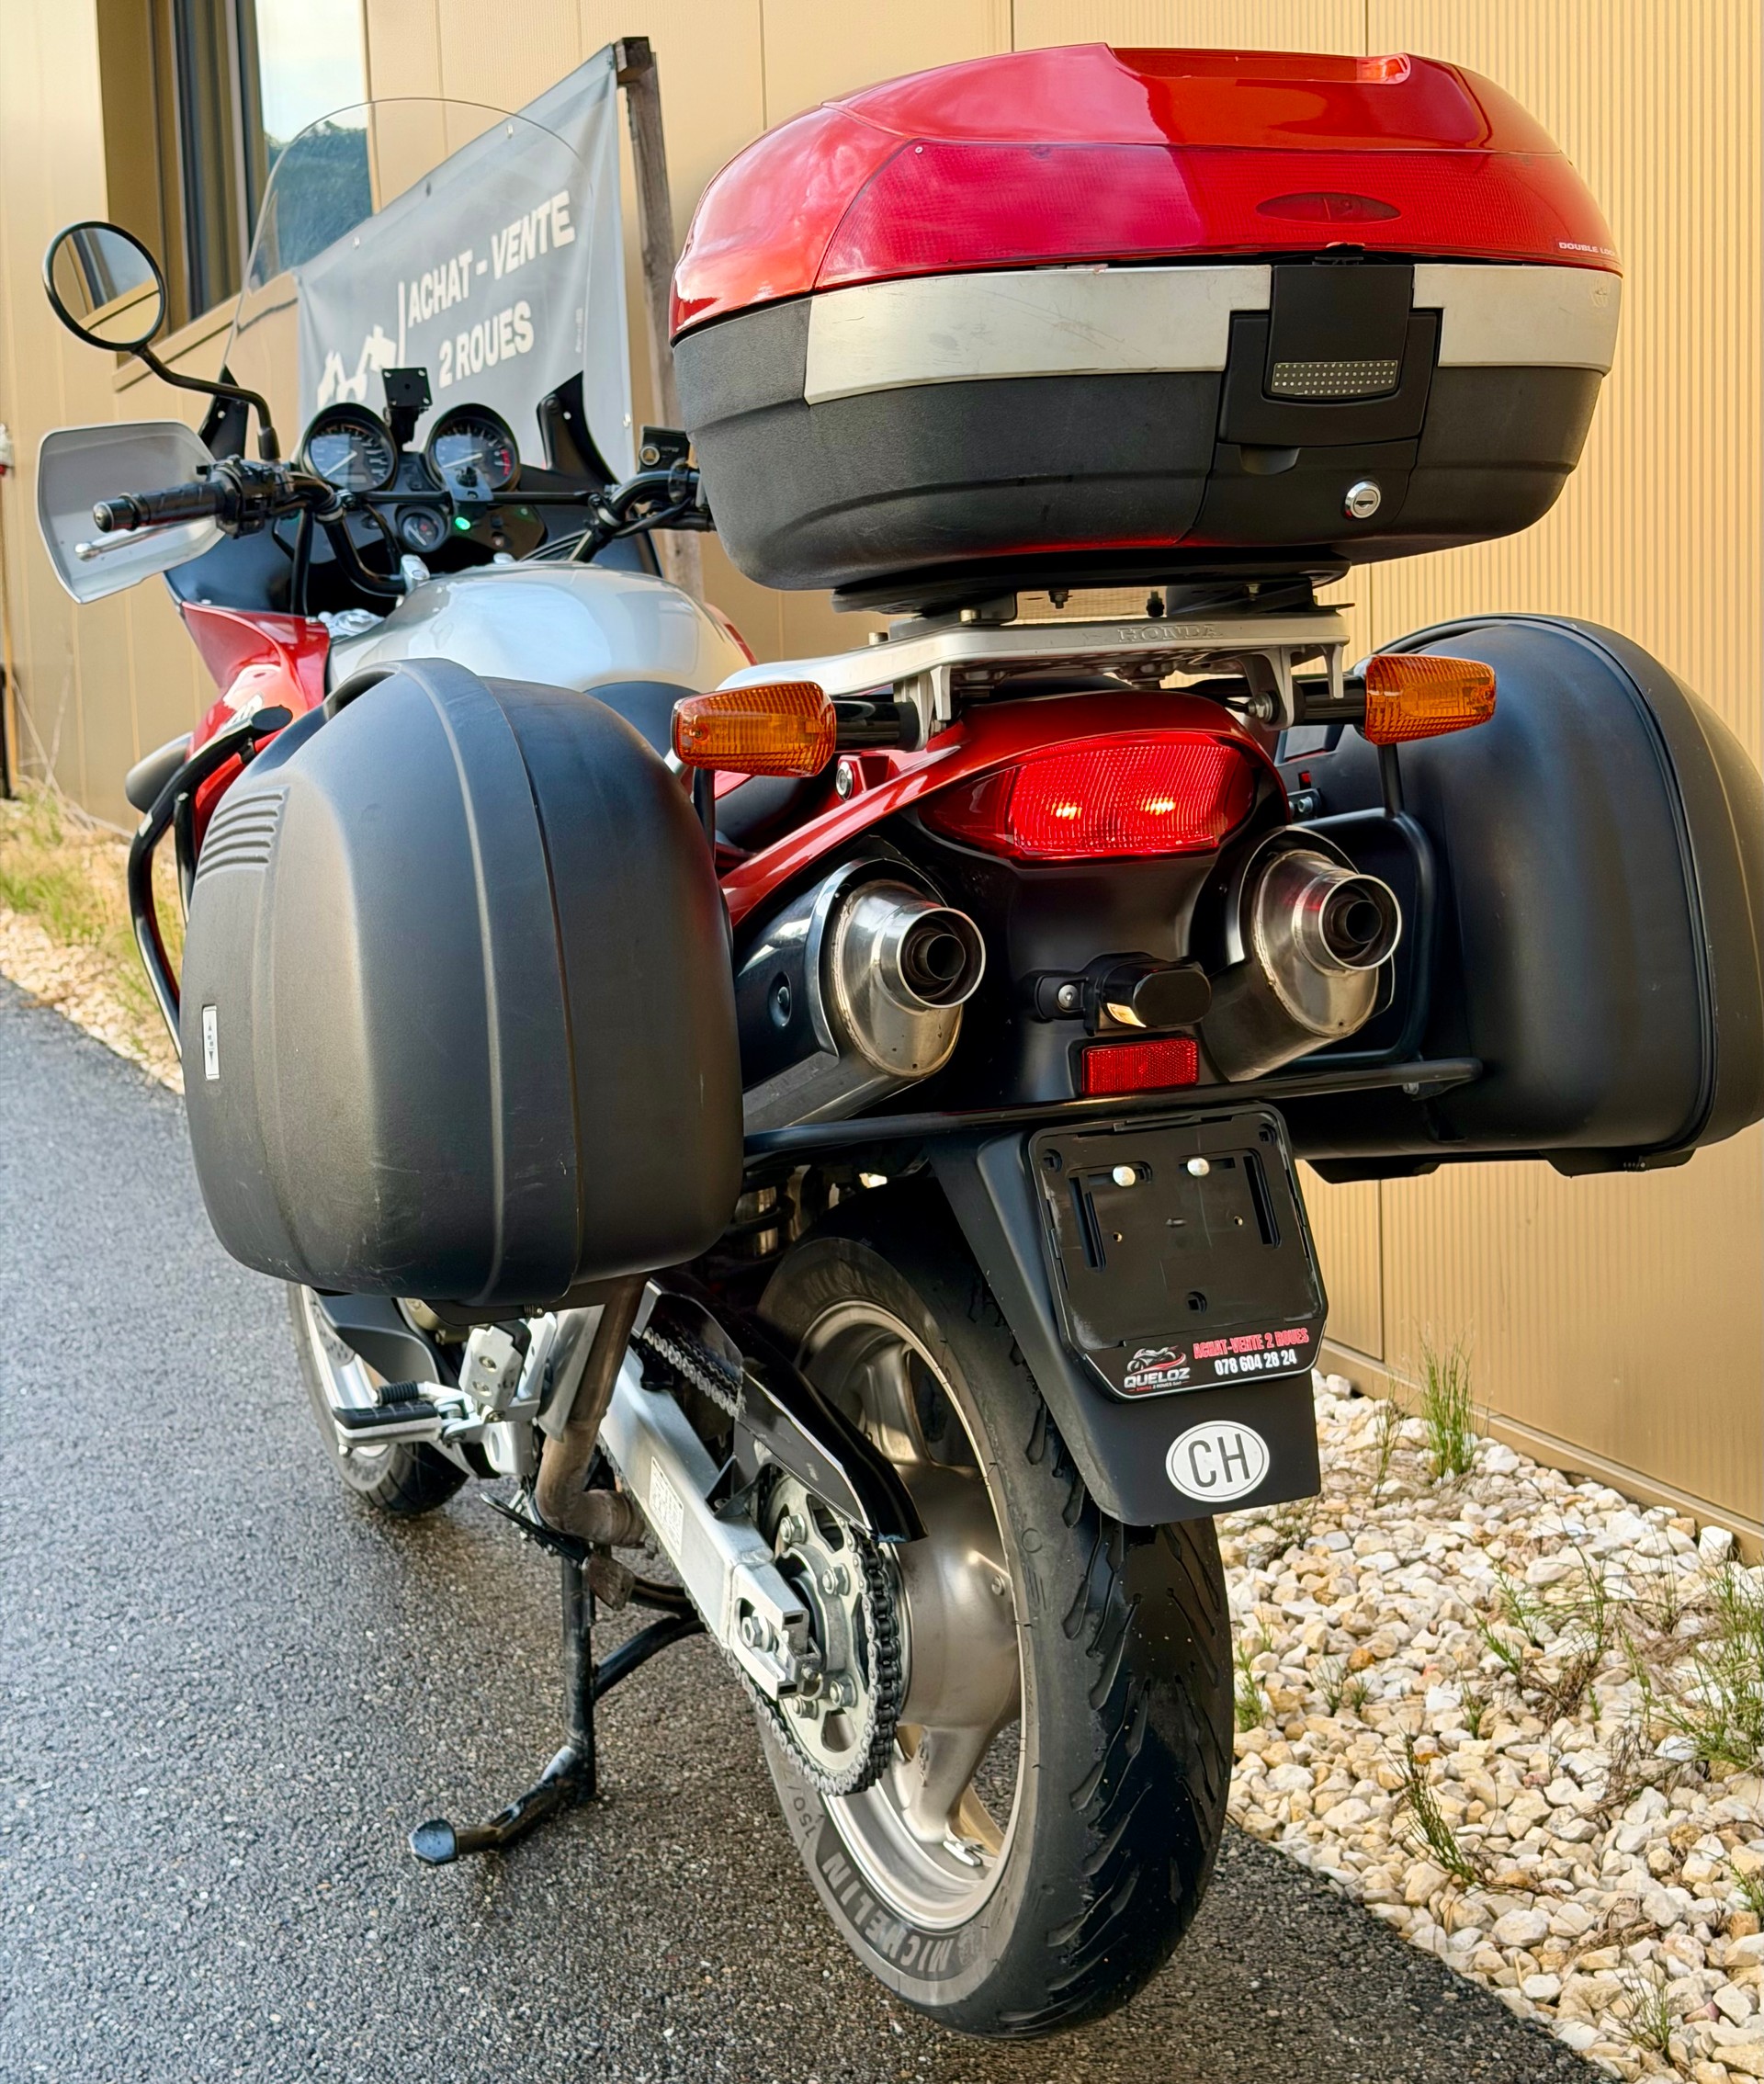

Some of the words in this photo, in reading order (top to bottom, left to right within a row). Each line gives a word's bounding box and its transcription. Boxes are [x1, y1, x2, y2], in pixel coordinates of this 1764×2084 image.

[407, 248, 473, 328] ACHAT
[491, 189, 576, 280] VENTE
[1558, 242, 1599, 253] DOUBLE
[438, 339, 453, 390] 2
[456, 300, 535, 378] ROUES
[1117, 624, 1223, 643] HONDA
[1193, 1333, 1265, 1360] ACHAT-VENTE
[1264, 1332, 1275, 1349] 2
[1274, 1327, 1309, 1347] ROUES
[1124, 1366, 1191, 1388] QUELOZ
[1214, 1357, 1238, 1376] 078
[1238, 1353, 1263, 1372] 604
[1263, 1351, 1280, 1368] 28
[1280, 1348, 1297, 1365] 24
[1188, 1433, 1251, 1489] CH
[821, 1852, 956, 1973] MICHELIN
